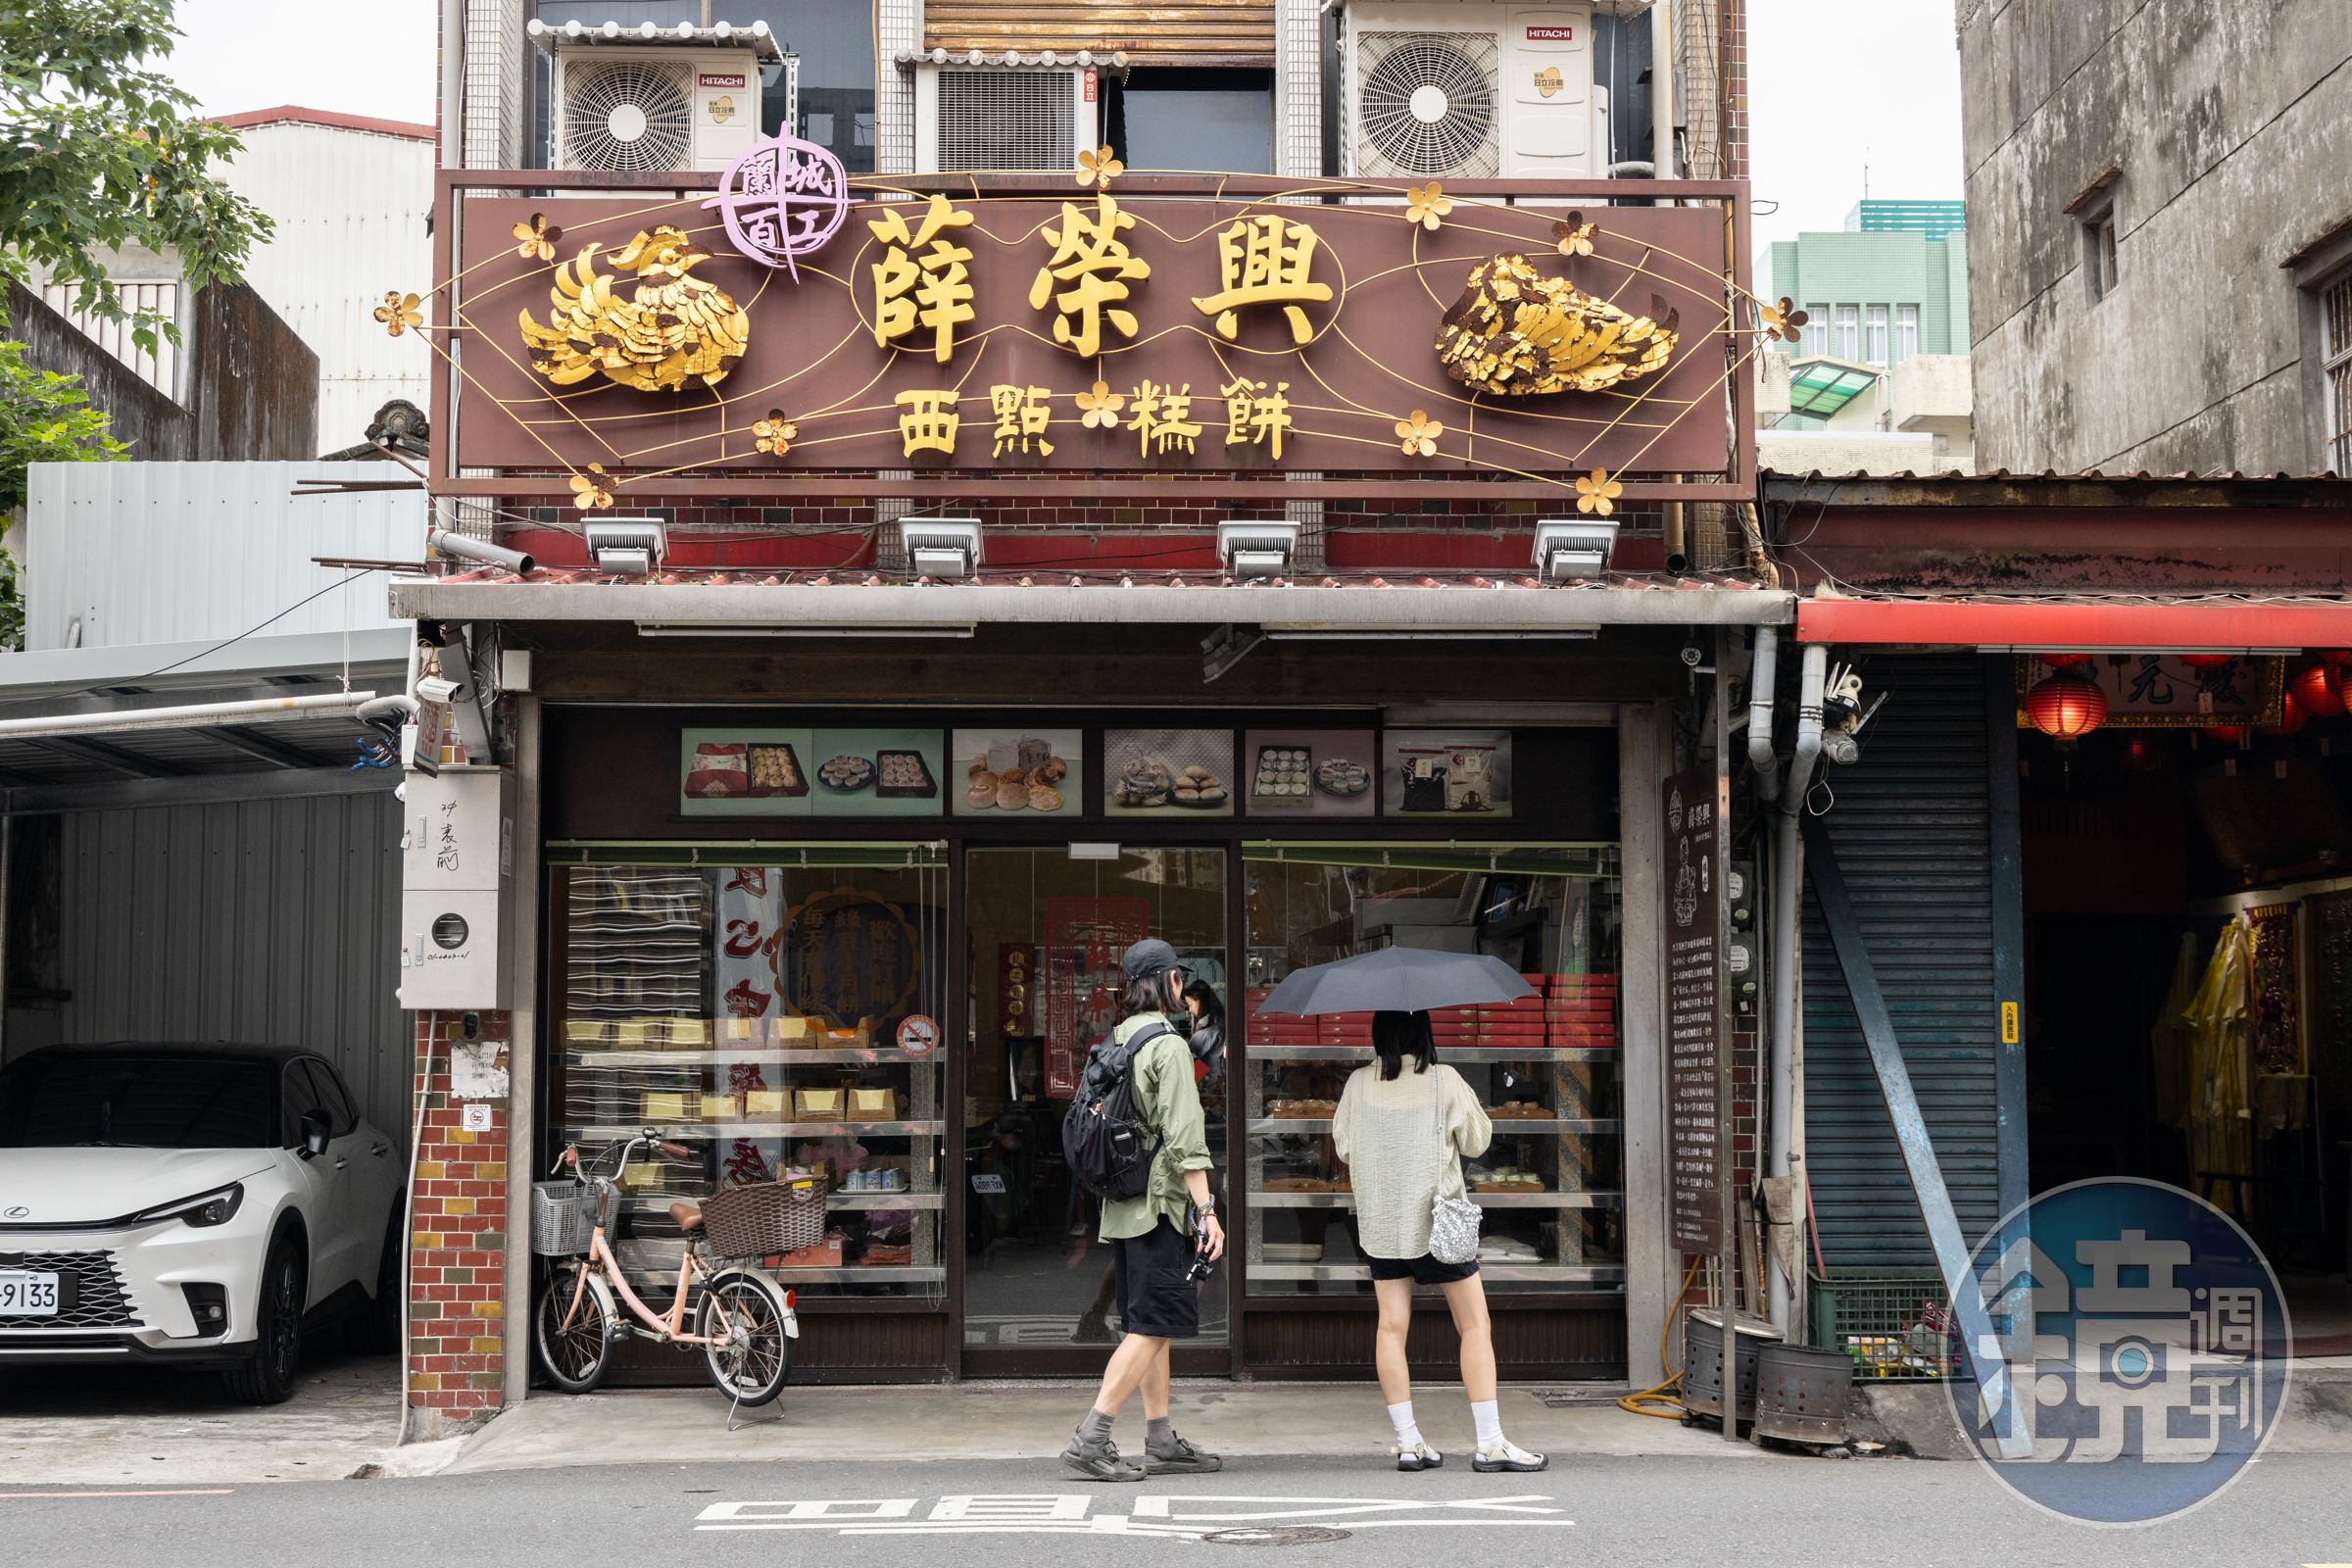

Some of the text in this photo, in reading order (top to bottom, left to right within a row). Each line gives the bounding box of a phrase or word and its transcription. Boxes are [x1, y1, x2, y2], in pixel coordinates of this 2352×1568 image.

[1529, 29, 1570, 38] HITACHI
[868, 194, 1334, 364] 薛榮興
[894, 375, 1292, 462] 西點糕餅
